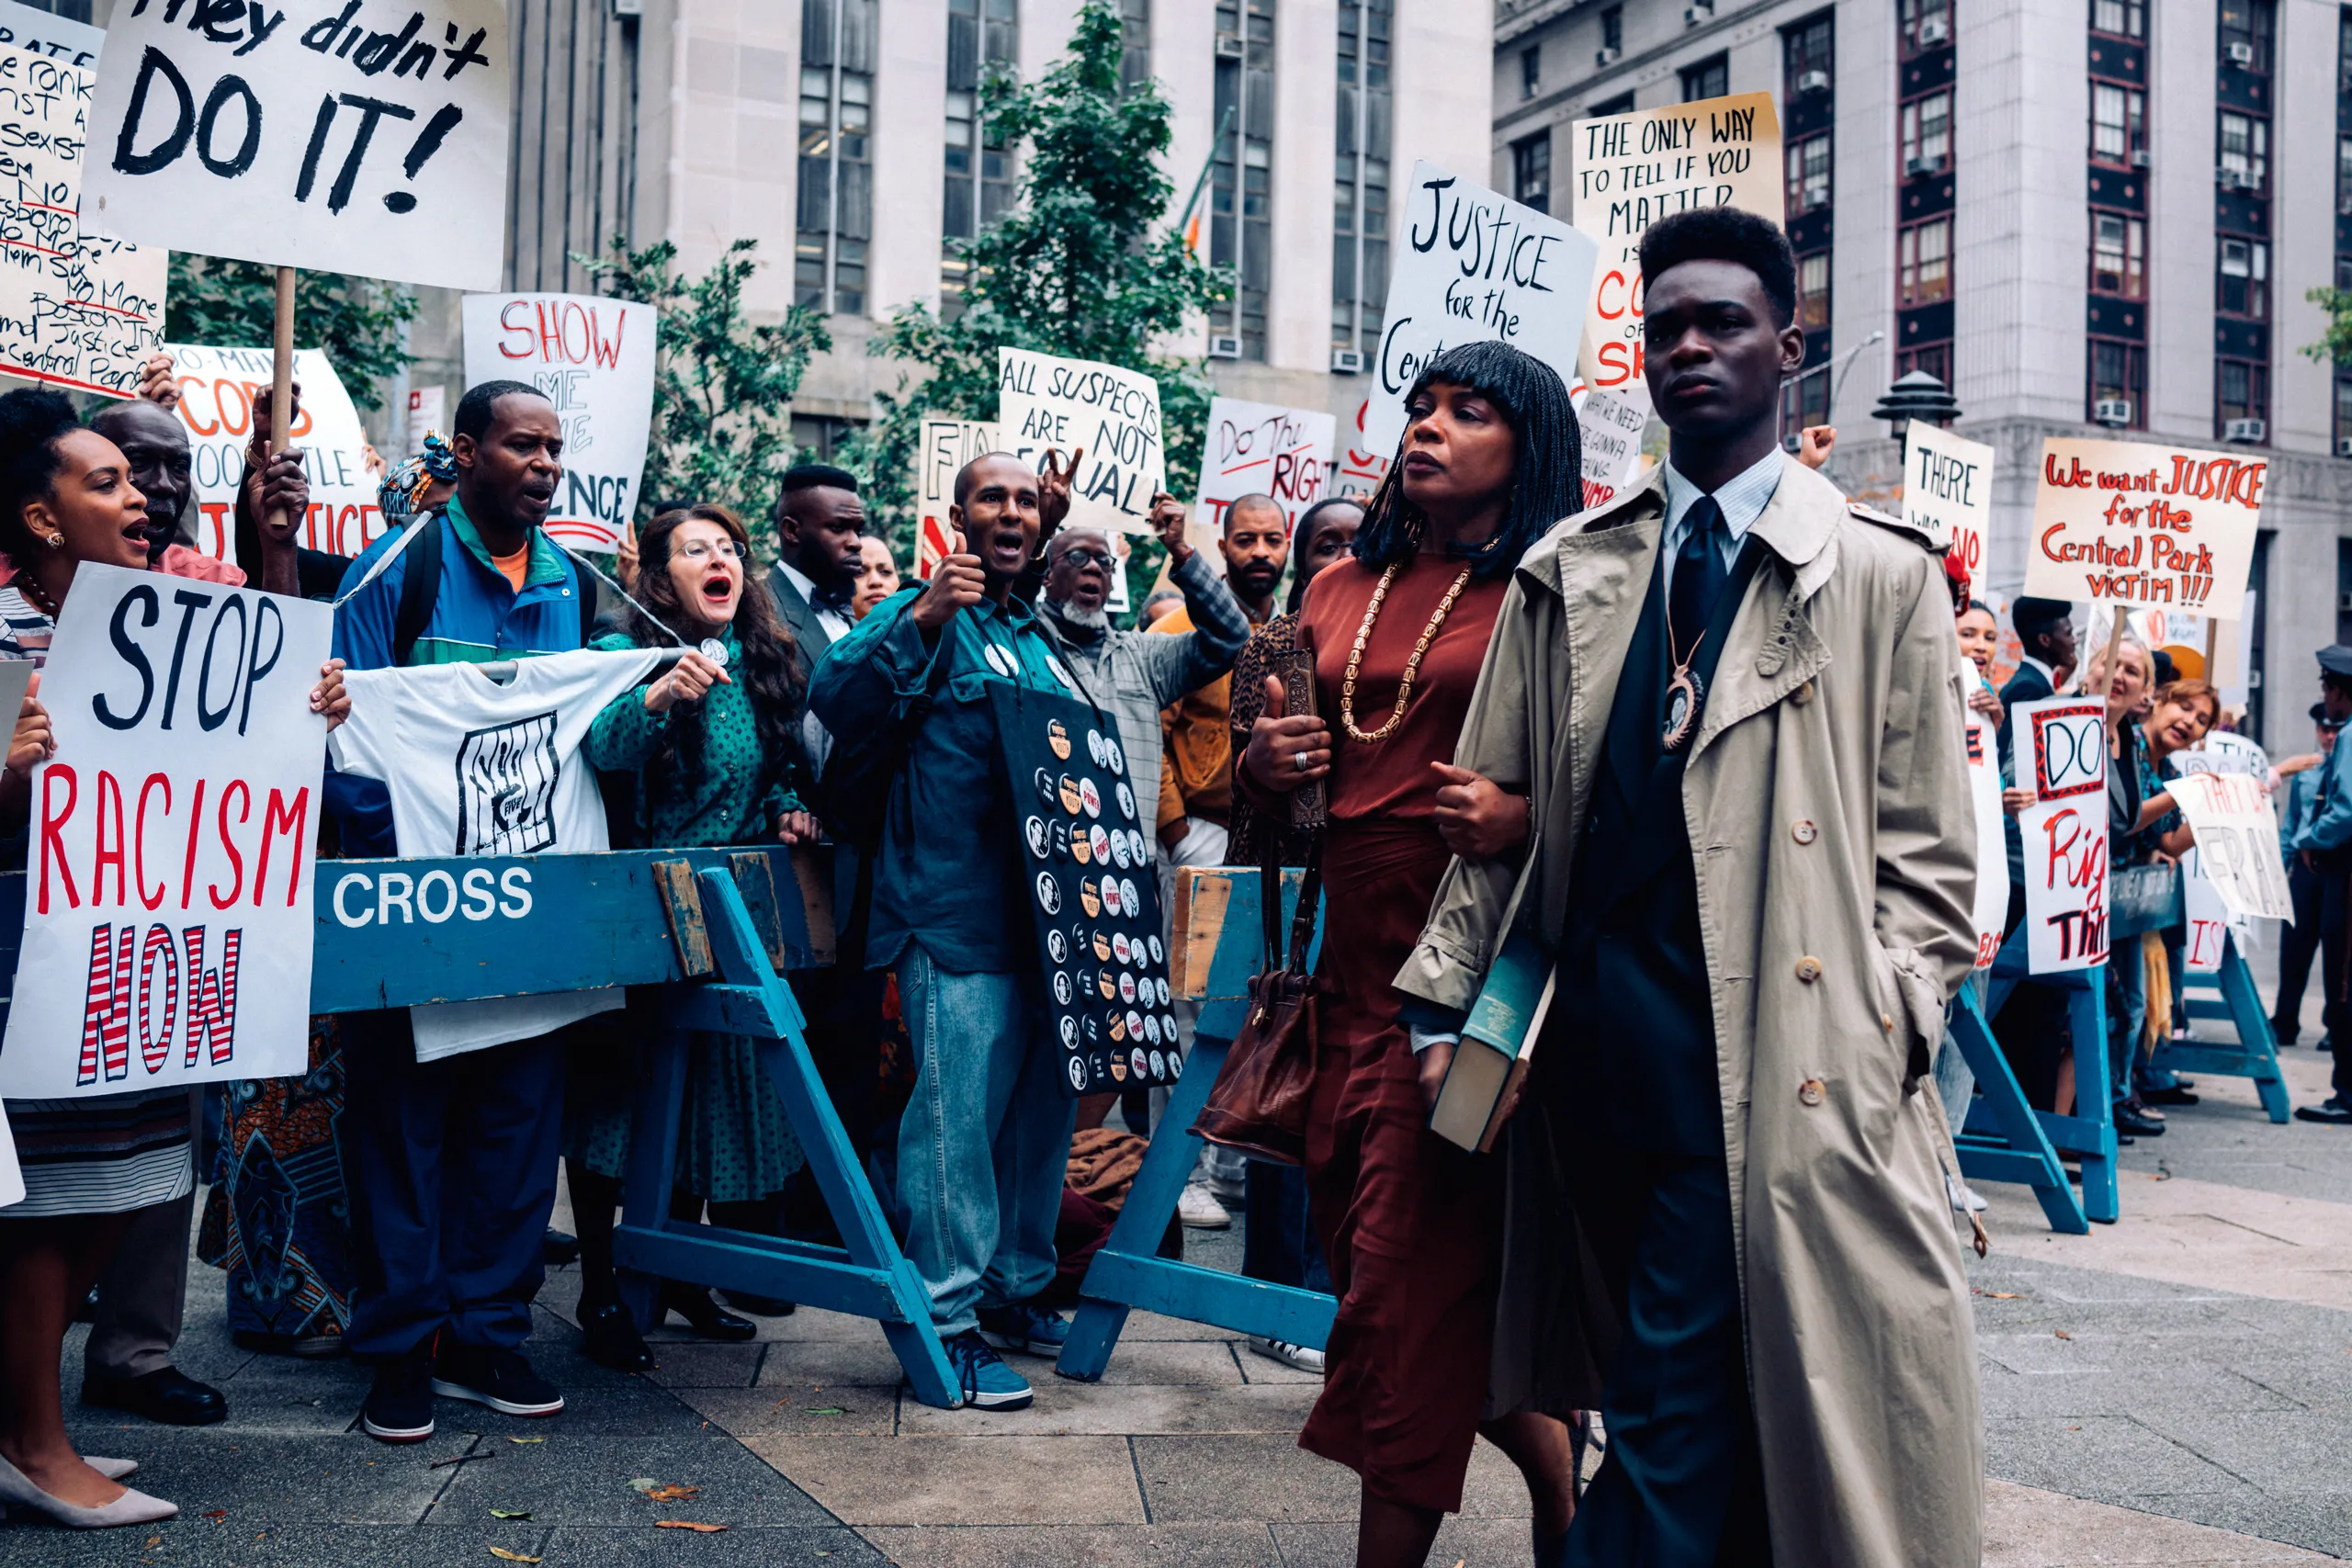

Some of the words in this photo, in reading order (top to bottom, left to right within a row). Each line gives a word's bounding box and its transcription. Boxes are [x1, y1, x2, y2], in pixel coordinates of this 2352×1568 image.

[131, 0, 286, 56] ey
[300, 0, 490, 81] didn't
[112, 44, 263, 178] DO
[294, 92, 463, 217] IT!
[1587, 122, 1632, 161] THE
[1642, 118, 1696, 154] ONLY
[1712, 107, 1755, 143] WAY
[18, 178, 69, 207] NO
[1580, 169, 1610, 199] TO
[1620, 163, 1665, 192] TELL
[1675, 156, 1697, 180] IF
[1708, 148, 1750, 177] YOU
[36, 226, 102, 265] More
[1412, 176, 1564, 292] JUSTICE
[102, 279, 157, 318] More
[50, 323, 139, 360] Justice
[499, 299, 627, 369] SHOW
[1000, 357, 1035, 396] ALL
[1048, 367, 1157, 437] SUSPECTS
[1021, 408, 1069, 443] ARE
[1092, 420, 1157, 470] NOT
[1220, 419, 1255, 464] Do
[1917, 446, 1978, 507] THERE
[2046, 454, 2092, 488] We
[2098, 468, 2161, 492] want
[2162, 456, 2267, 509] JUSTICE
[2103, 493, 2143, 527] for
[2145, 500, 2192, 533] the
[1951, 525, 1980, 570] NO
[2041, 522, 2143, 568] Central
[2151, 534, 2213, 574] Park
[93, 583, 284, 736] STOP
[2045, 718, 2104, 787] DO
[1083, 790, 1100, 810] POWER
[37, 762, 310, 915] RACISM
[1095, 837, 1110, 859] POWER
[2043, 808, 2109, 912] Rig
[334, 867, 533, 929] CROSS
[1105, 892, 1121, 905] POWER
[1115, 944, 1130, 957] POWER
[76, 922, 243, 1087] NOW
[1122, 986, 1135, 996] POWER
[1134, 1059, 1147, 1072] POWER
